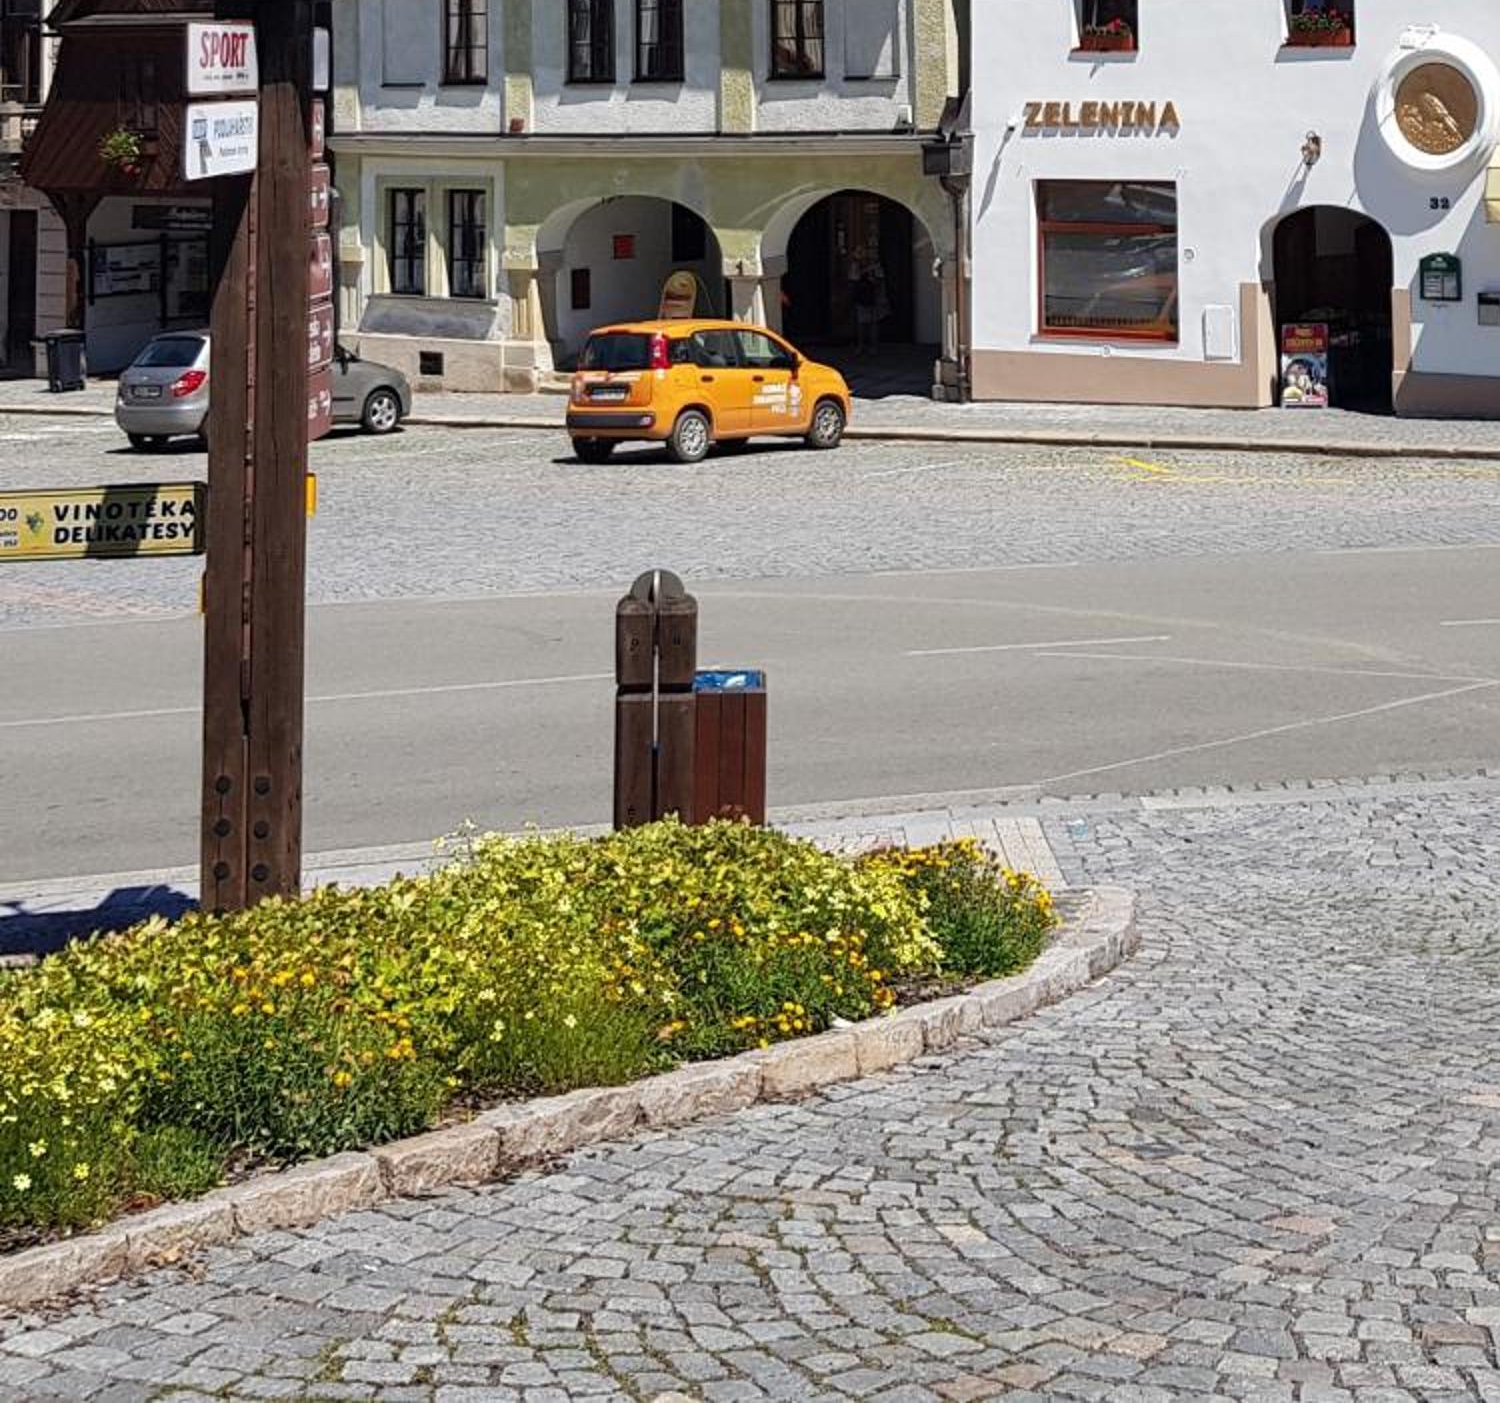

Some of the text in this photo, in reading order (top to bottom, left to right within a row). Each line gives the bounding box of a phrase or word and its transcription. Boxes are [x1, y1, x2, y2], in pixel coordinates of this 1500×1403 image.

[199, 30, 249, 69] SPORT
[1024, 100, 1180, 128] ZELENINA
[1429, 197, 1450, 210] 32
[53, 497, 196, 522] VINOTÉKA
[54, 522, 195, 544] DELIKATESY
